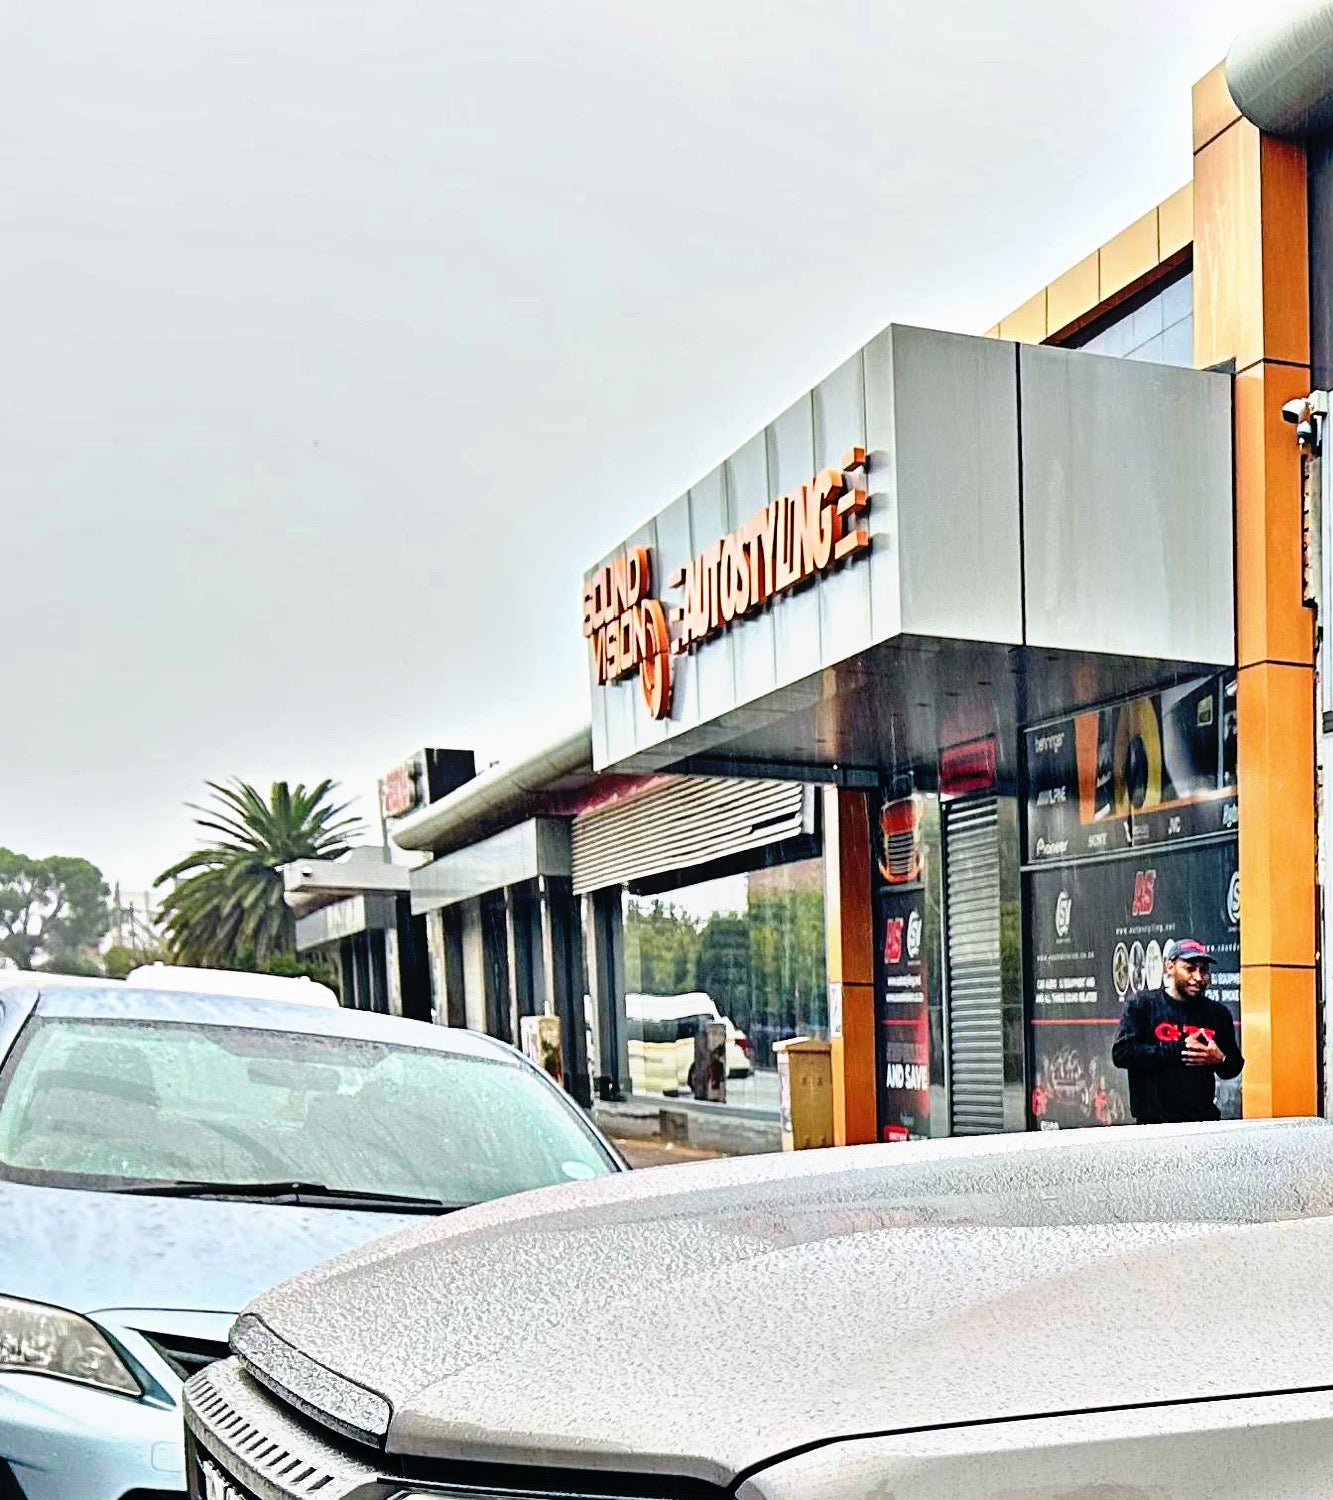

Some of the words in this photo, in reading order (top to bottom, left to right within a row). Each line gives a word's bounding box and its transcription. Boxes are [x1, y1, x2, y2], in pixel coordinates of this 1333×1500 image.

[583, 544, 651, 638] SOUND
[681, 467, 845, 651] AUTOSTYLING
[590, 603, 648, 685] VISION
